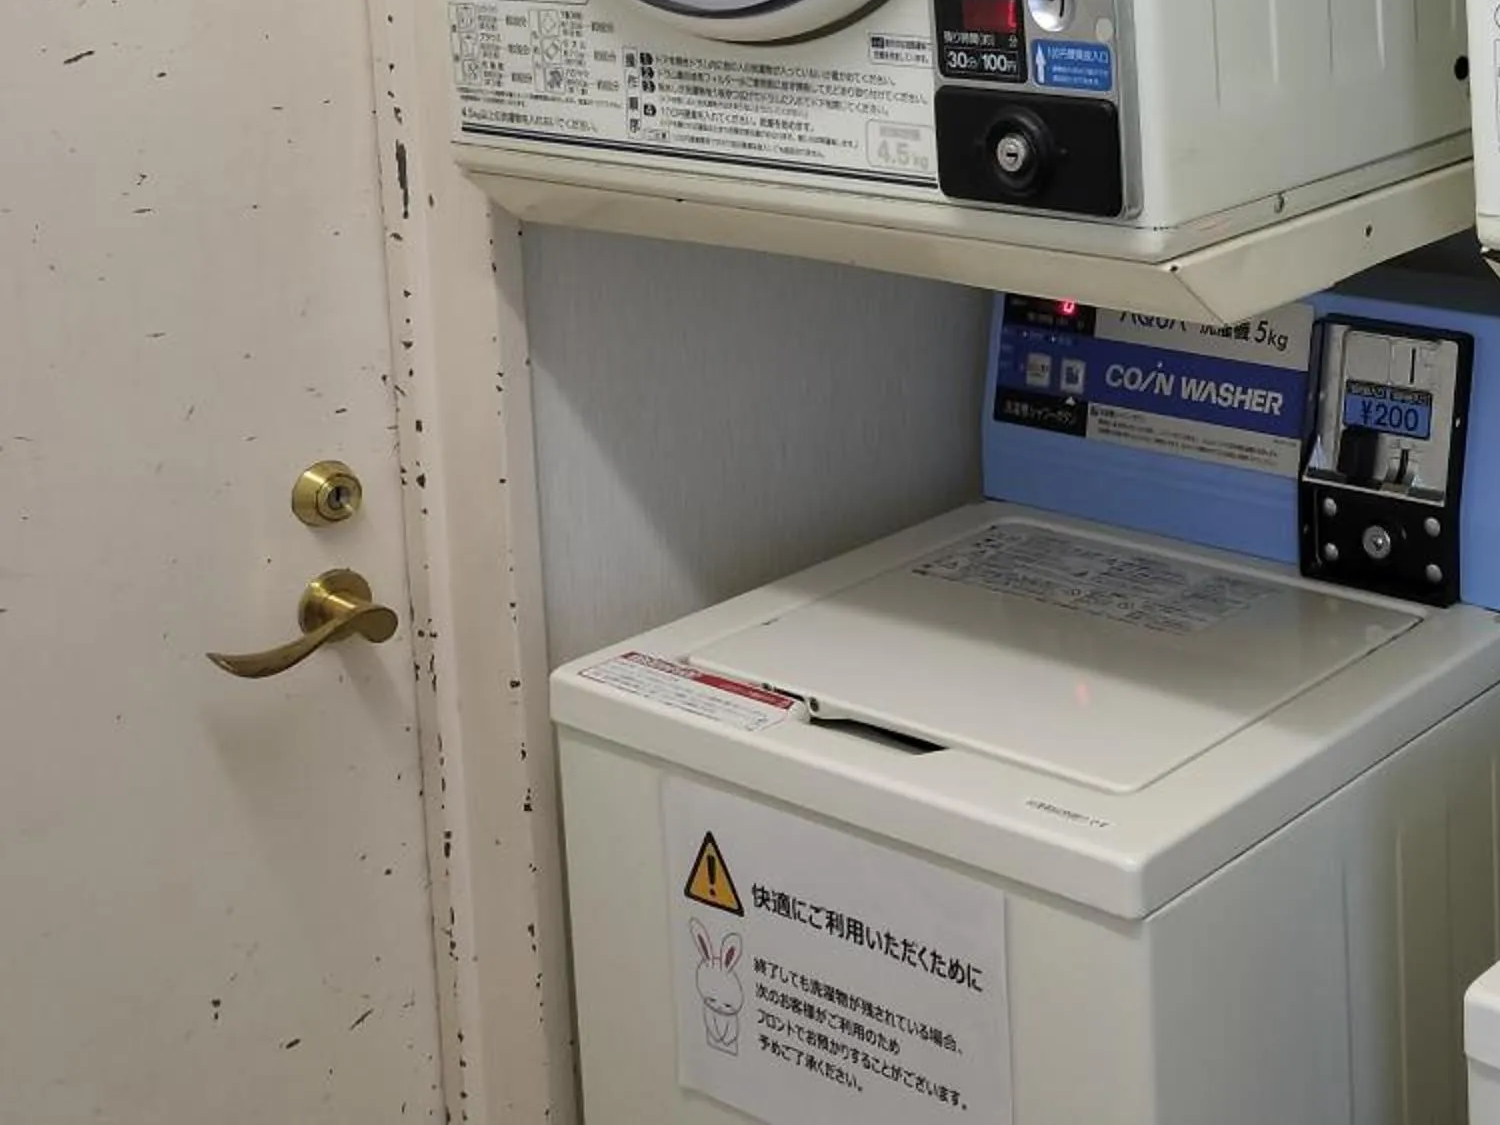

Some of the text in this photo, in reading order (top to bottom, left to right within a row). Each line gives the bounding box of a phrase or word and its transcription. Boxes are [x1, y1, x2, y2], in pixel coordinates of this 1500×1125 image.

[1254, 320, 1289, 352] 5kg
[1105, 361, 1283, 416] COIN WASHER
[1361, 400, 1419, 431] ¥200
[752, 883, 983, 993] 快適にご利用いただくために
[753, 957, 964, 1055] 終了しても洗濯物が残されている場合、
[755, 982, 900, 1055] 次のお客様がご利用のため
[756, 1010, 968, 1109] フロントでお預かりすることがございます。
[758, 1034, 863, 1092] 予めご了承ください。
